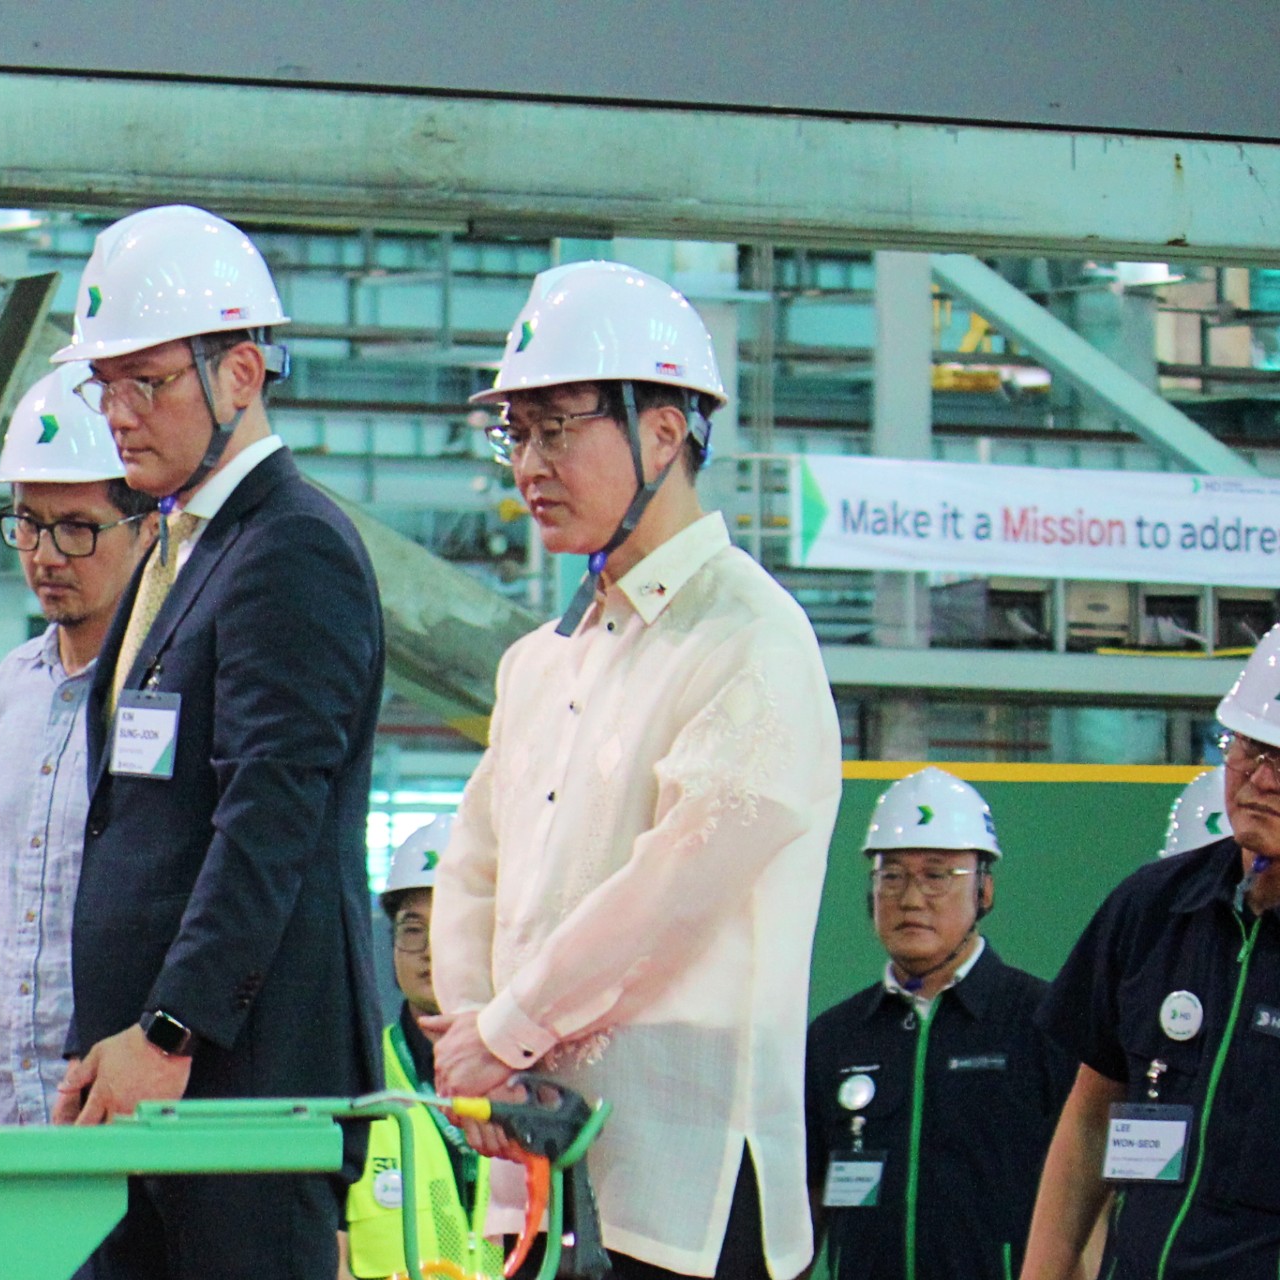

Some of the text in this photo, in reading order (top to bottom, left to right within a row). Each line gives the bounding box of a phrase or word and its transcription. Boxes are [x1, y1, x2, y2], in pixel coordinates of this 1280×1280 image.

[841, 499, 1280, 554] Make it a Mission to addre
[1115, 1124, 1130, 1133] LEE
[1112, 1138, 1161, 1149] WON-SEOB
